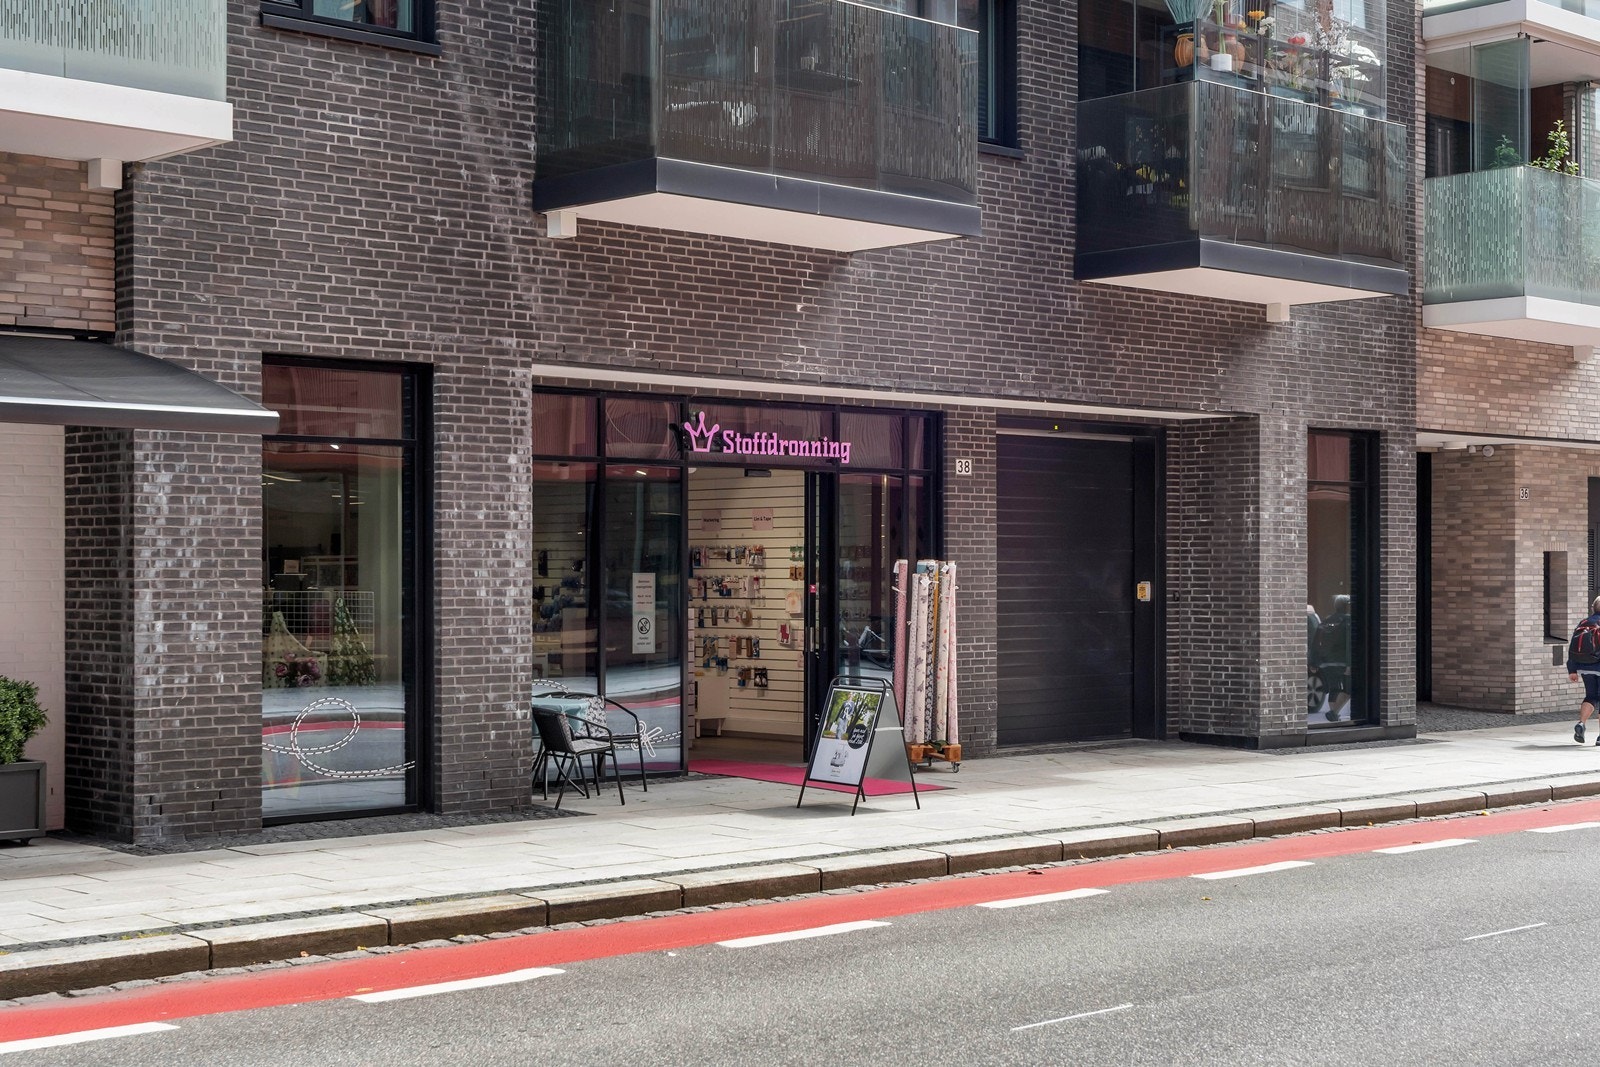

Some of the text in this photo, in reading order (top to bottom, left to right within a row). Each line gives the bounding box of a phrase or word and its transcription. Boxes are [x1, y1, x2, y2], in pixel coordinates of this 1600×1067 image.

[722, 429, 851, 464] Stoffdronning
[957, 460, 970, 473] 38
[1520, 488, 1529, 499] 36
